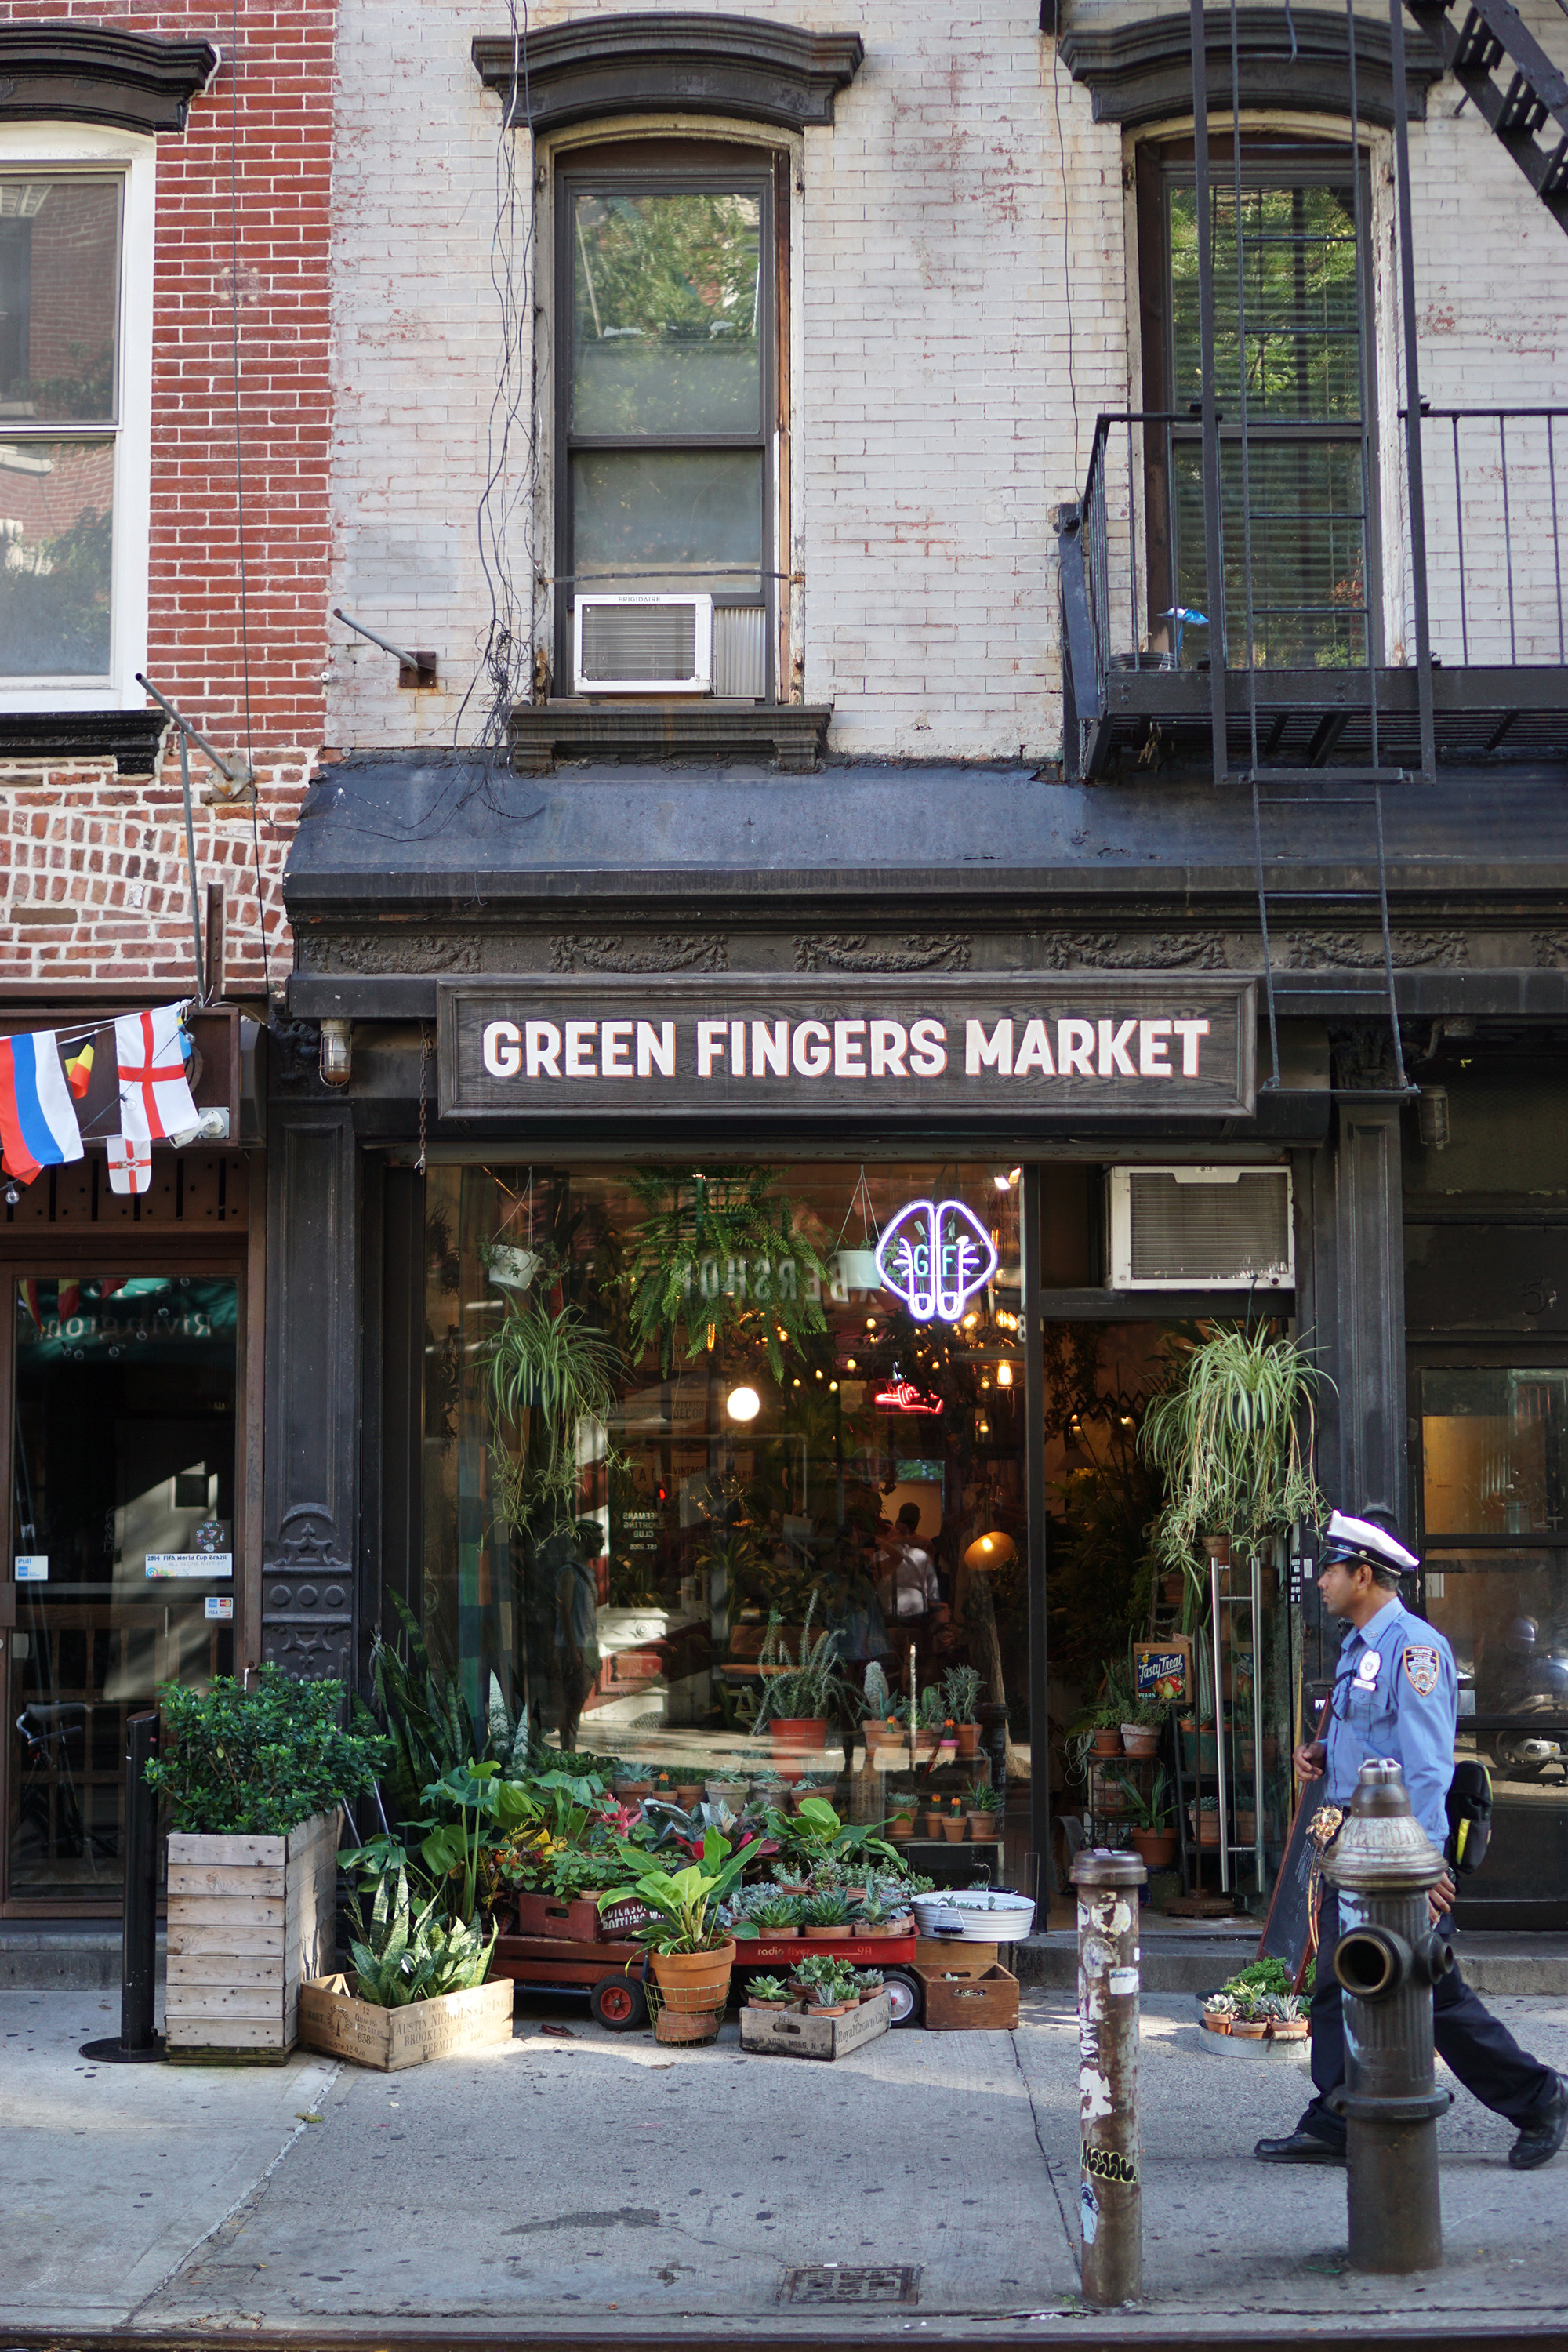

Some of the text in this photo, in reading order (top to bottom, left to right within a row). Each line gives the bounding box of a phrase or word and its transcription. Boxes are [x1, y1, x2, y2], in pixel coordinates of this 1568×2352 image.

[483, 1018, 1210, 1078] GREEN FINGERS MARKET
[913, 1244, 956, 1276] G F
[1523, 1274, 1548, 1315] 5
[673, 1408, 705, 1419] DECOR
[1138, 1653, 1183, 1684] Tasty Treat
[757, 1946, 872, 1958] radio flyer 9A
[362, 2006, 370, 2016] 12
[395, 2019, 427, 2036] AUSTIN
[431, 2008, 472, 2027] NICHOLS
[405, 2026, 449, 2046] BROOKLYN
[838, 2024, 855, 2043] Royal
[423, 2038, 453, 2055] PERMIT
